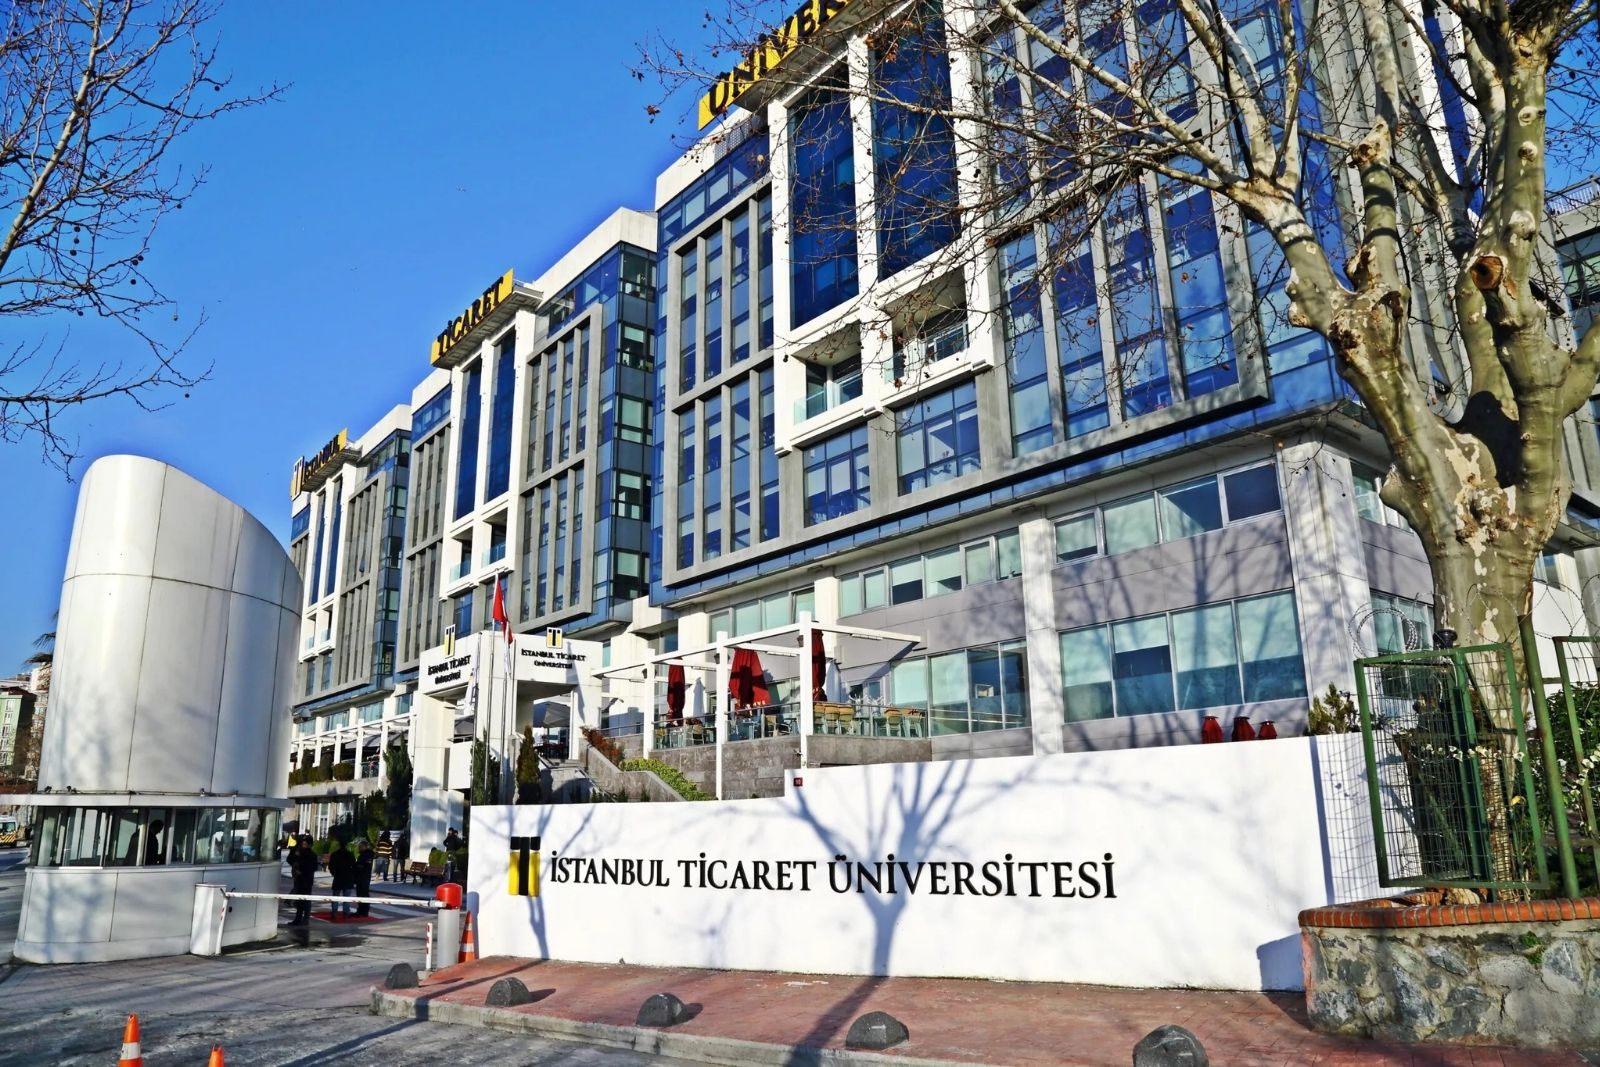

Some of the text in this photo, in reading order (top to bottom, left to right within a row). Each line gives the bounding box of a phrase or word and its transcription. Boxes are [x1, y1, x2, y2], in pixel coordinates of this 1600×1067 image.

[437, 276, 504, 355] TİCARET
[550, 850, 1117, 898] İSTANBUL TİCARET ÜNİVERSİTESİ
